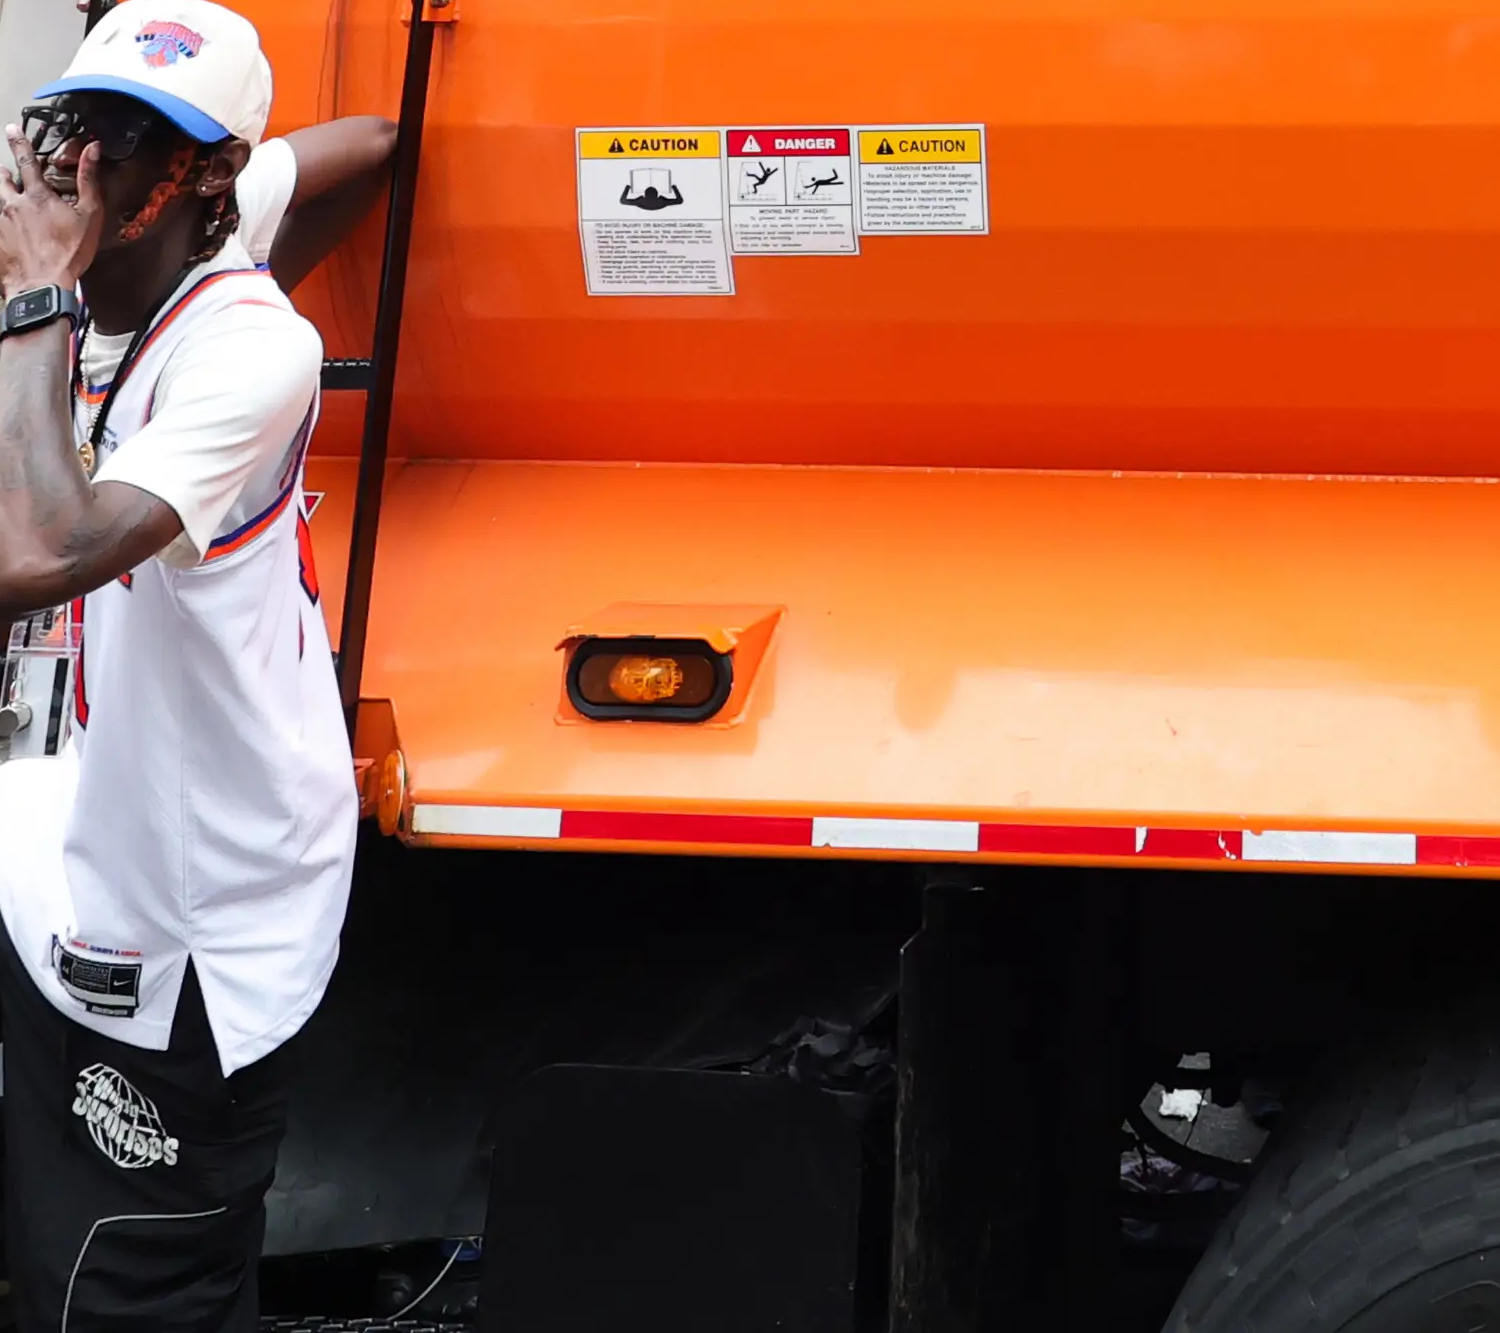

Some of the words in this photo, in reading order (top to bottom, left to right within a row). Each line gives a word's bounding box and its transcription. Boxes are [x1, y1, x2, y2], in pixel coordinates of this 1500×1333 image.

[628, 138, 699, 152] CAUTION
[774, 138, 837, 151] DANGER
[898, 139, 966, 152] CAUTION
